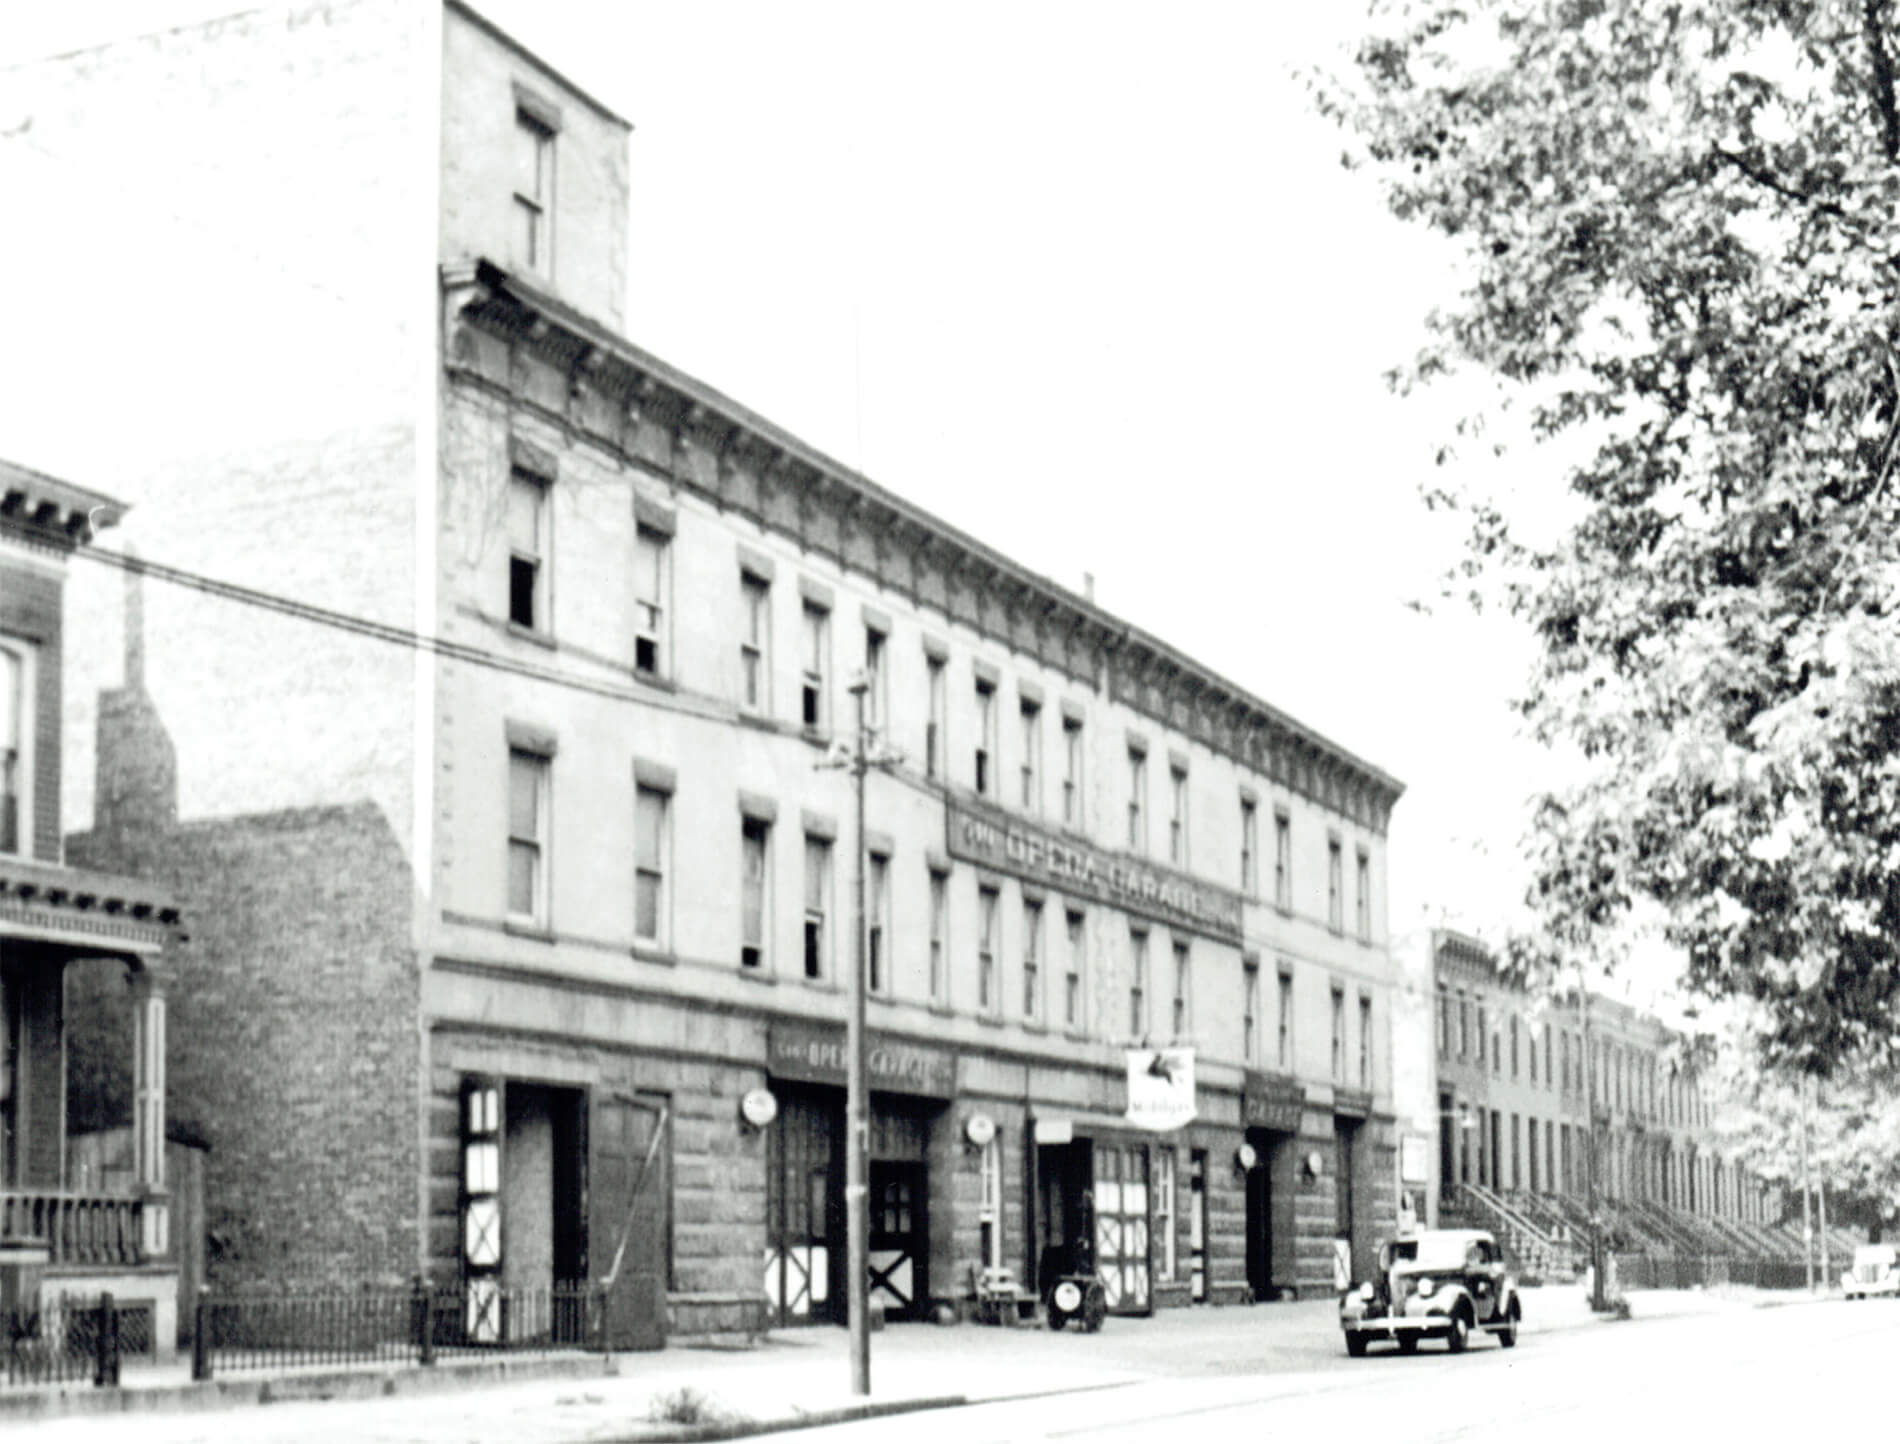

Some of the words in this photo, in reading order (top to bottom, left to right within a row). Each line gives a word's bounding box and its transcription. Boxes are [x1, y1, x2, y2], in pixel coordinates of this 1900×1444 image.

[1007, 828, 1100, 886] OPERA
[1109, 862, 1200, 916] GARAGE
[808, 1043, 848, 1070] OPER
